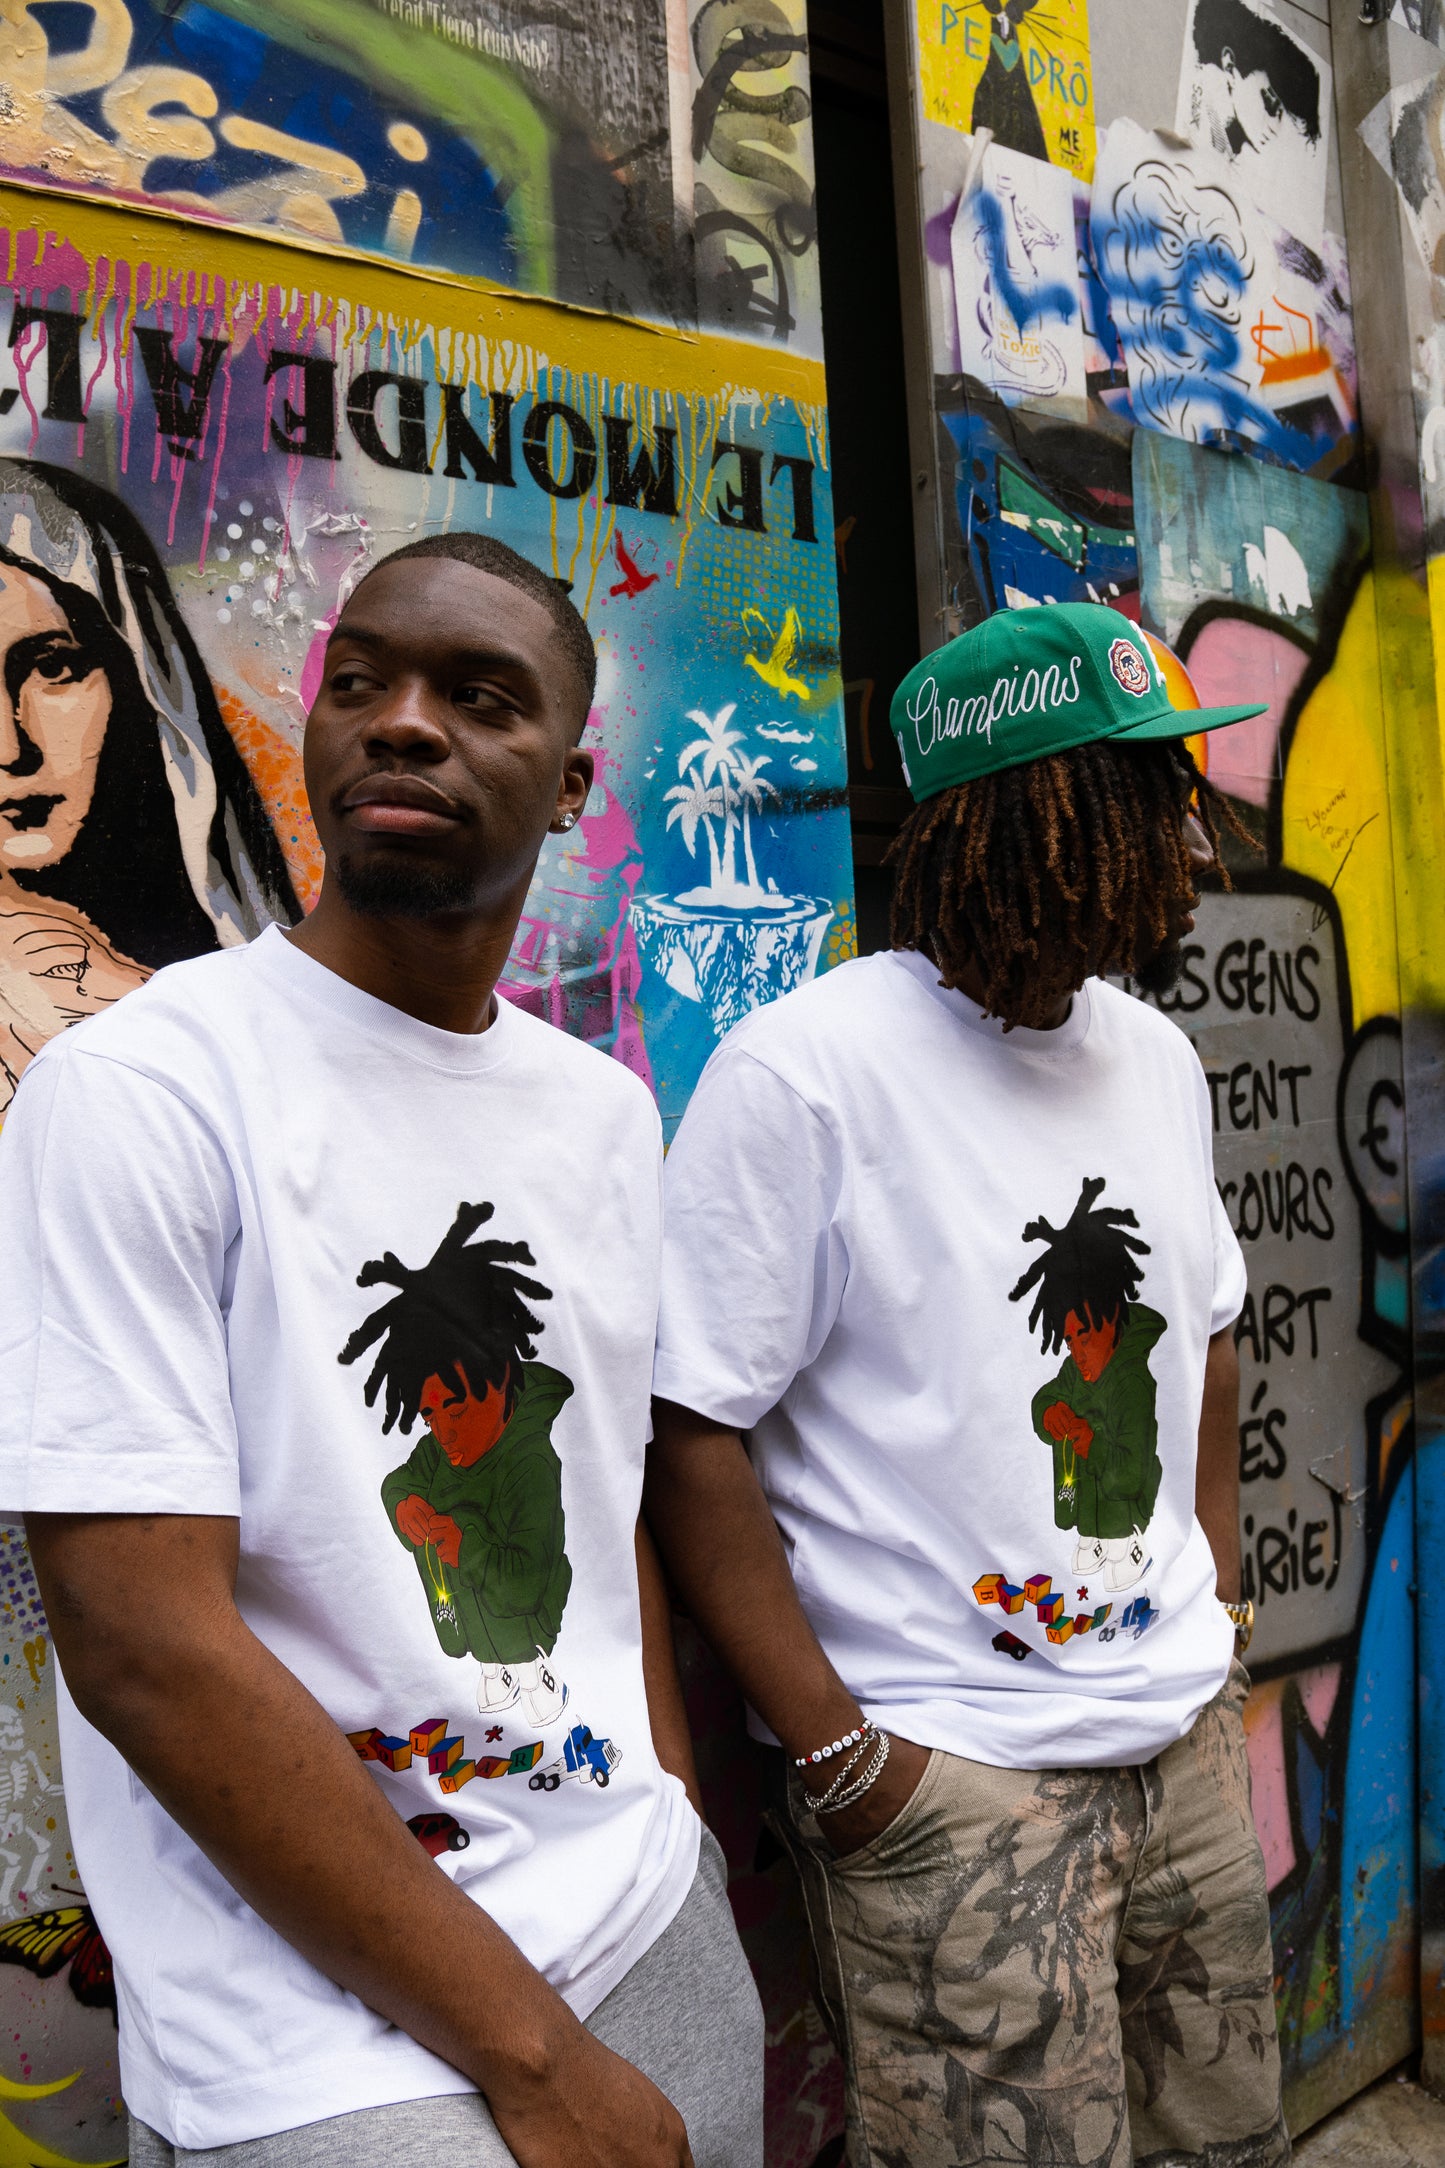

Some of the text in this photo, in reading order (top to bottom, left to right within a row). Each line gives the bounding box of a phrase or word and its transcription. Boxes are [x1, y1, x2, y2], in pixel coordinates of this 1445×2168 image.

[941, 3, 984, 61] PE
[265, 348, 682, 518] MONDE
[711, 436, 819, 544] LE
[906, 655, 1082, 757] Champions
[1214, 938, 1321, 1022] GENS
[1131, 1545, 1143, 1565] B
[501, 1670, 512, 1688] B
[542, 1669, 555, 1693] B
